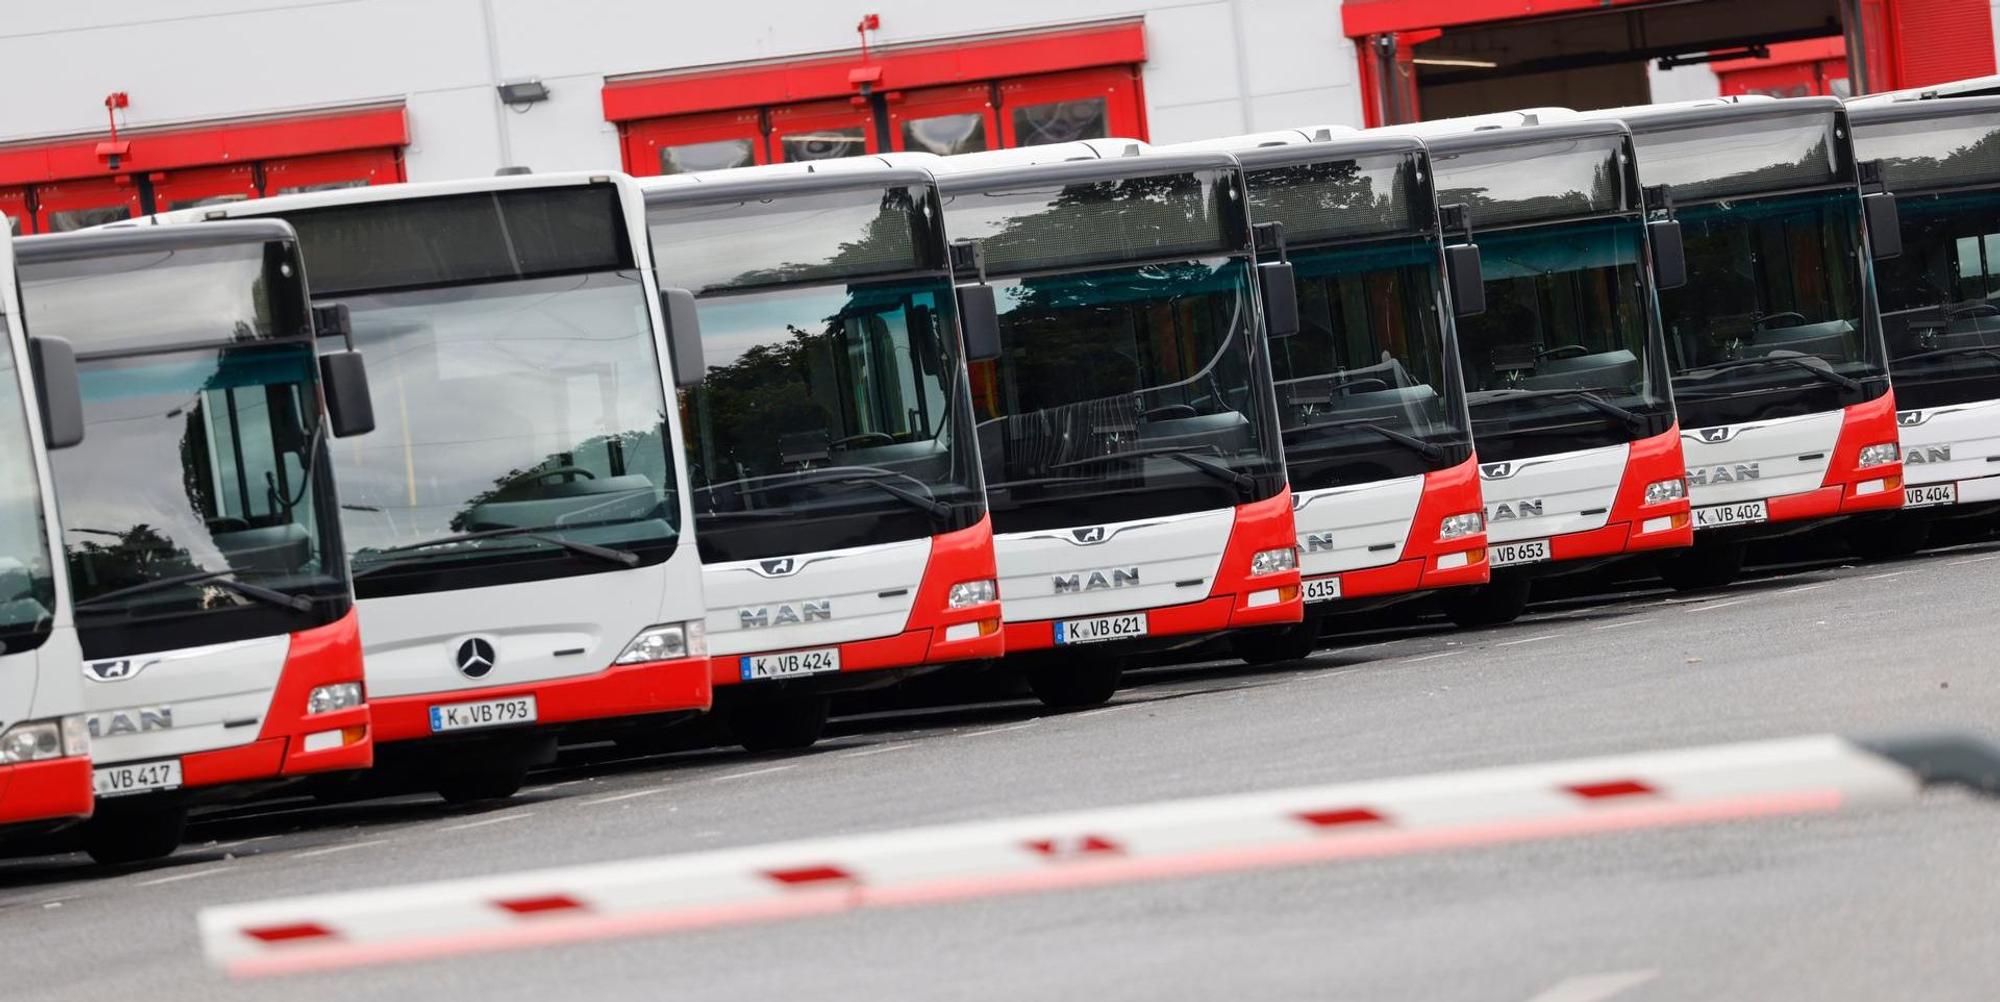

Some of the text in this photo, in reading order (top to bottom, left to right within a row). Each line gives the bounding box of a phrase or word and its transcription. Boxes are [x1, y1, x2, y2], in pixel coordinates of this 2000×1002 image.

[1904, 443, 1951, 466] AN
[1686, 462, 1760, 486] MAN
[1906, 486, 1950, 504] VB 404
[1483, 499, 1543, 521] AN
[1697, 510, 1707, 525] K
[1715, 506, 1734, 522] VB
[1736, 503, 1761, 520] 402
[1497, 542, 1544, 562] VB 653
[1052, 566, 1140, 594] MAN
[1307, 580, 1334, 598] 615
[738, 599, 832, 630] MAN
[1069, 616, 1141, 639] K VB 621
[756, 658, 767, 676] K
[777, 654, 799, 673] VB
[802, 651, 832, 670] 424
[447, 700, 528, 726] K VB 793
[109, 769, 134, 789] VB
[138, 764, 170, 786] 417
